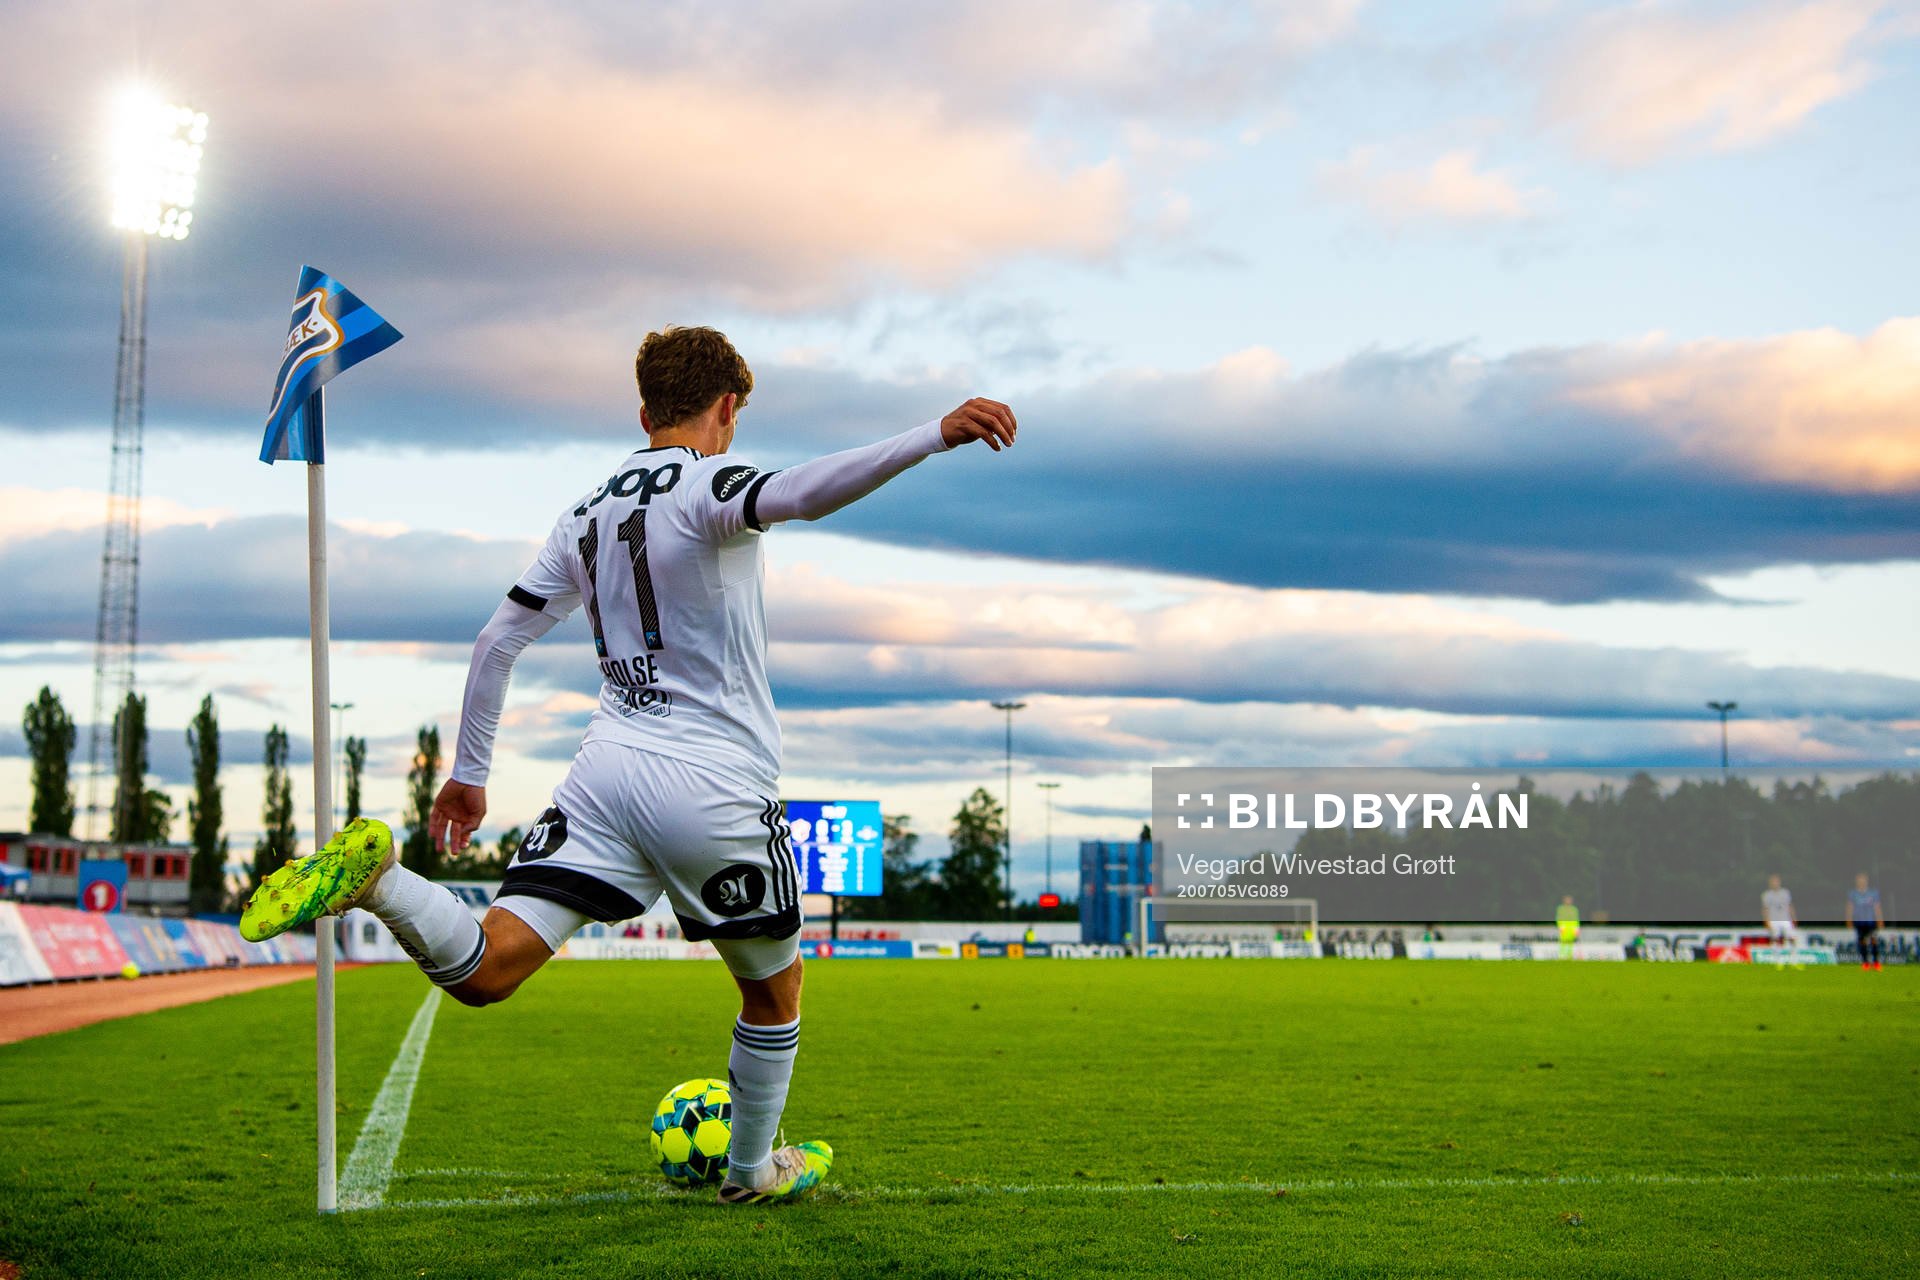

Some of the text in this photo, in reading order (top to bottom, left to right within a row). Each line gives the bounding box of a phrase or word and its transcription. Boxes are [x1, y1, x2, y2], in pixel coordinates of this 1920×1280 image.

[578, 508, 664, 657] 11
[601, 653, 659, 688] HOLSE
[91, 884, 108, 910] 1
